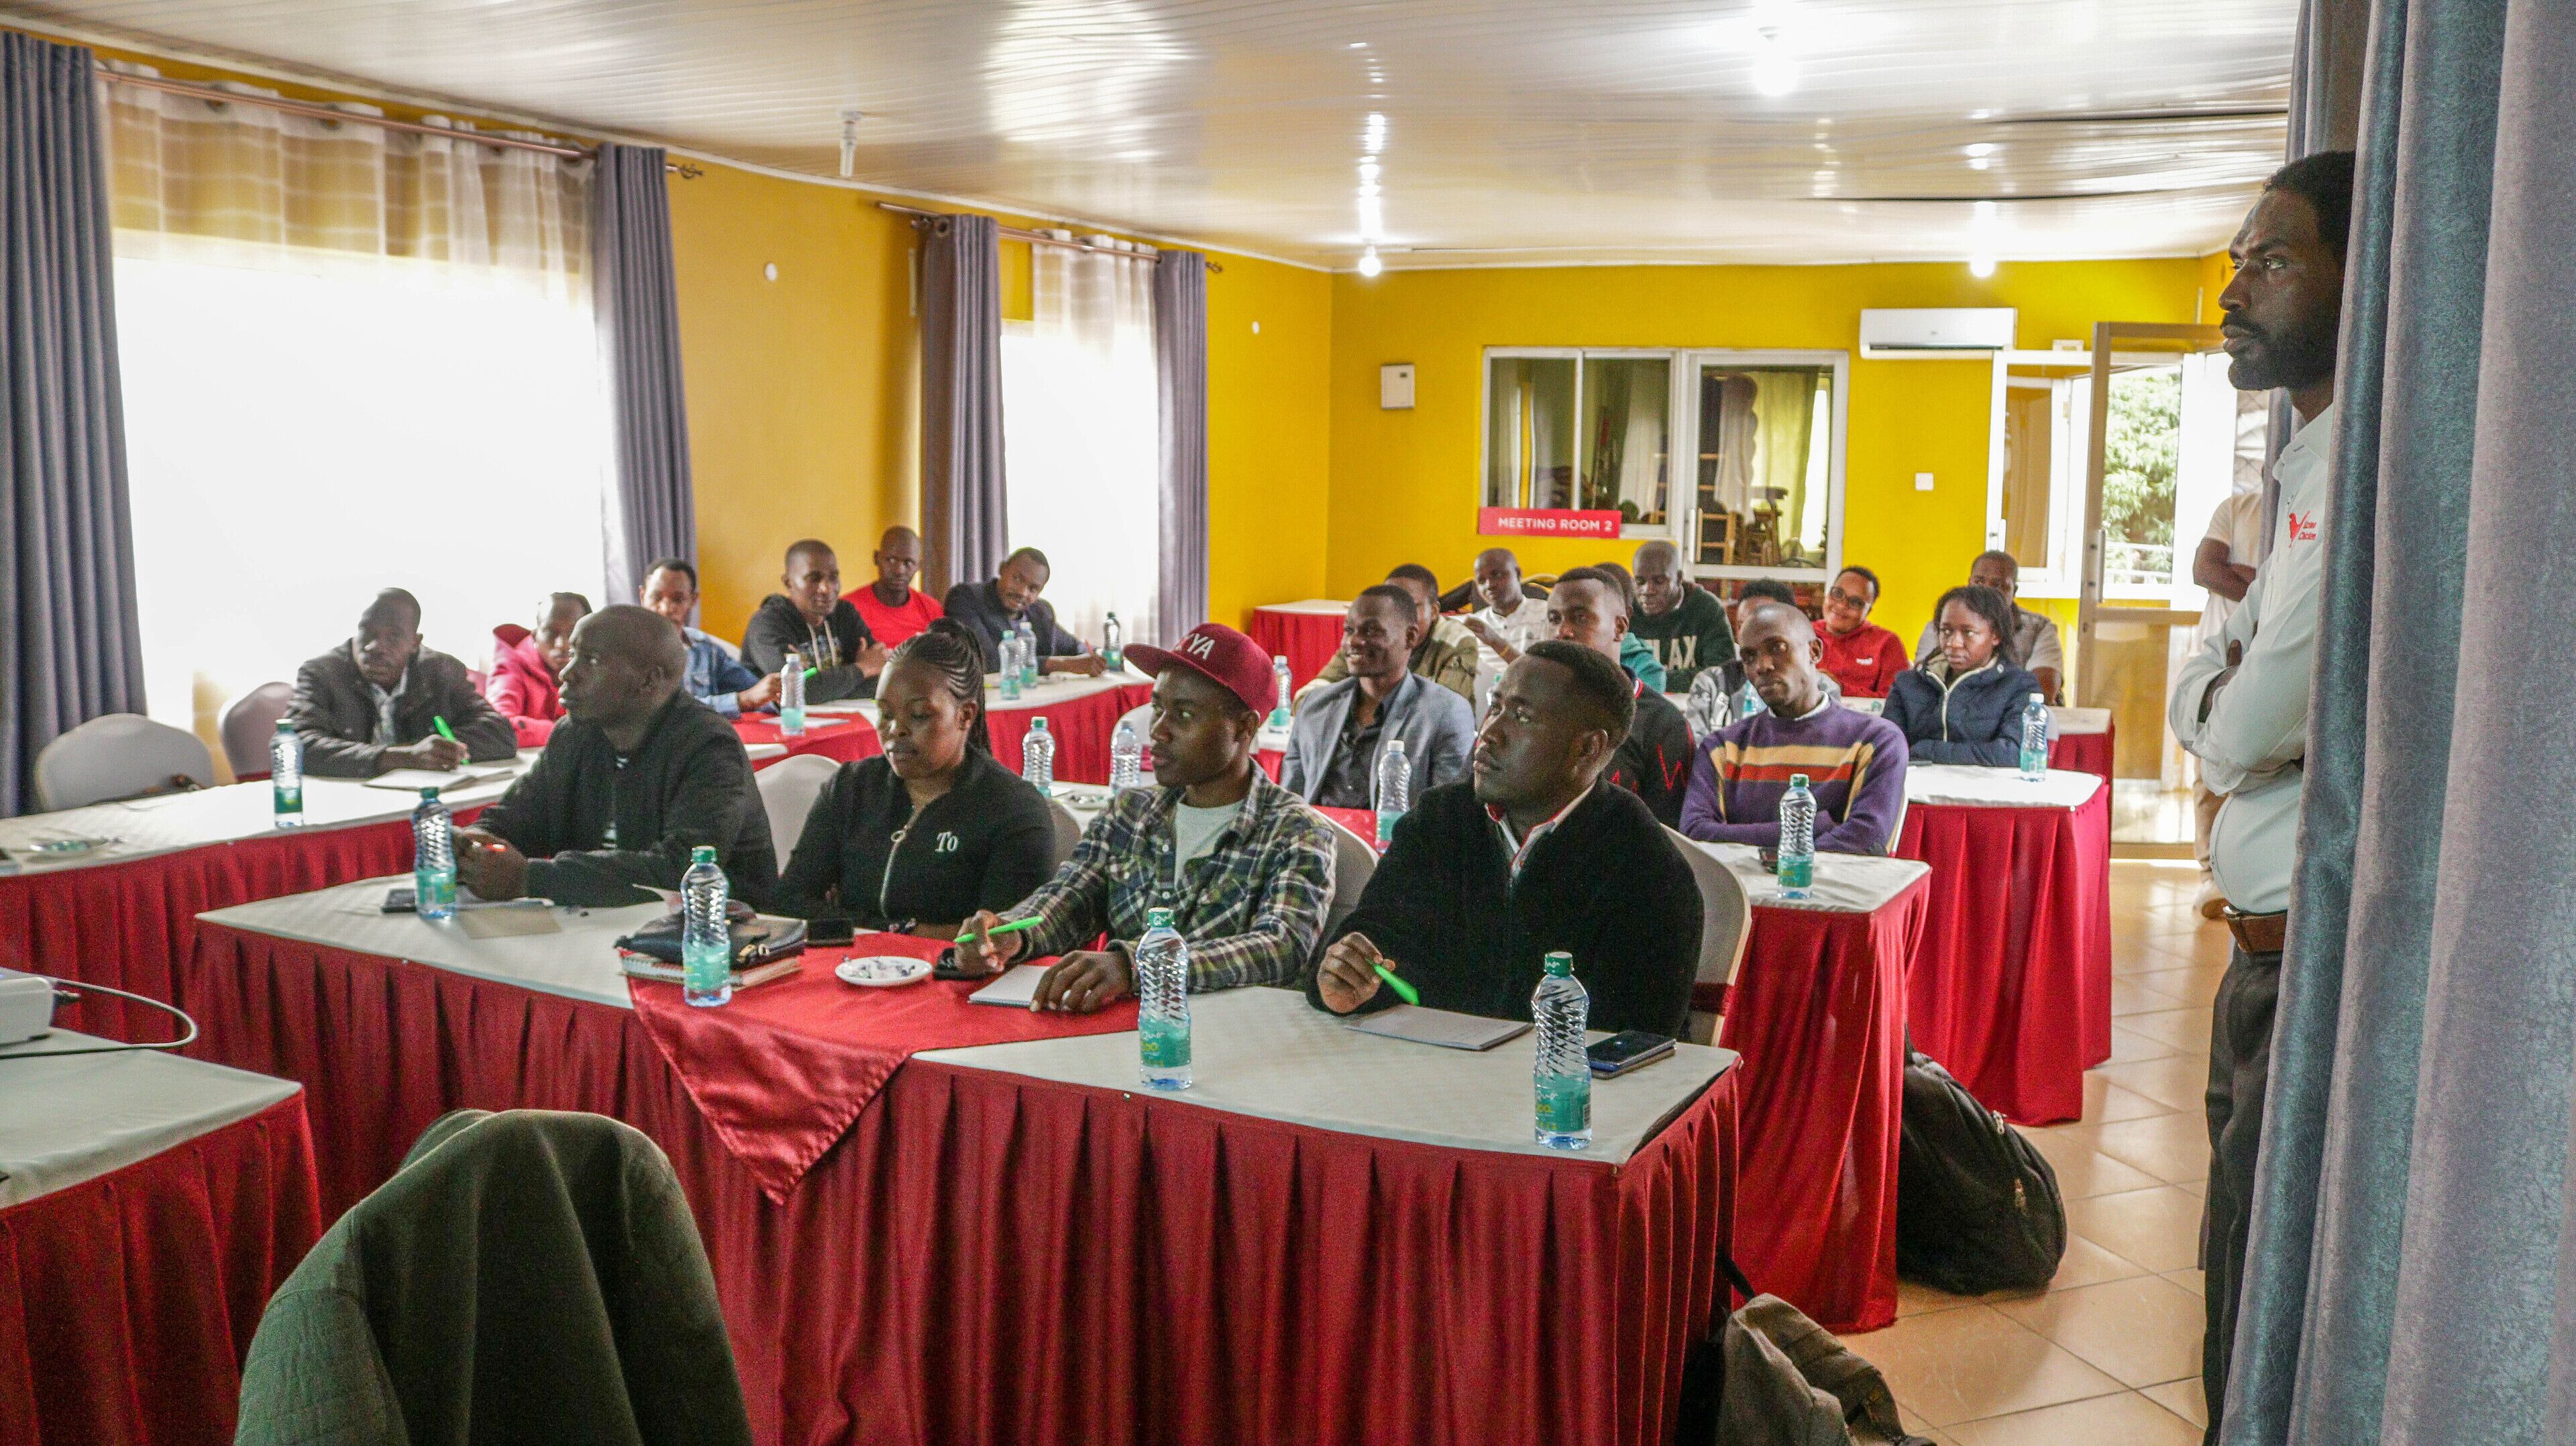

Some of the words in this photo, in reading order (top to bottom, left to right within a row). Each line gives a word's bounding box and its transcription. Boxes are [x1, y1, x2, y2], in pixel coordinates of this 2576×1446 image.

[1498, 517, 1556, 529] MEETING
[1560, 518, 1600, 531] ROOM
[1604, 520, 1613, 531] 2
